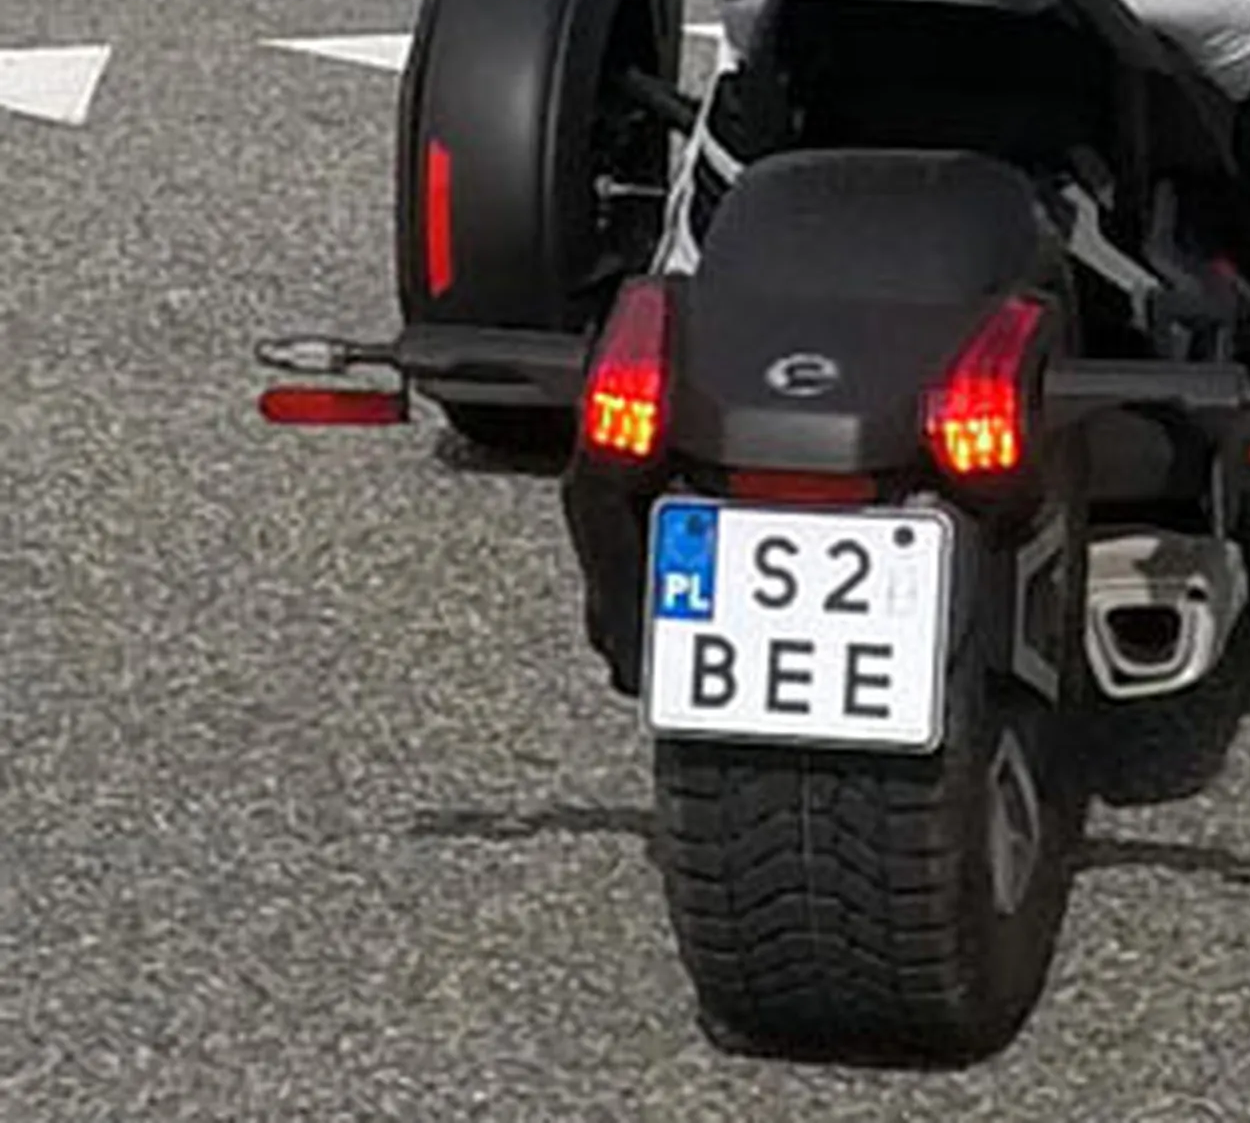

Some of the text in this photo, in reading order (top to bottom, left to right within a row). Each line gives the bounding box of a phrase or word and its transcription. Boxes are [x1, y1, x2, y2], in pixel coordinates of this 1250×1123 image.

[662, 572, 711, 612] PL
[752, 535, 871, 614] S2
[691, 633, 893, 719] BEE
